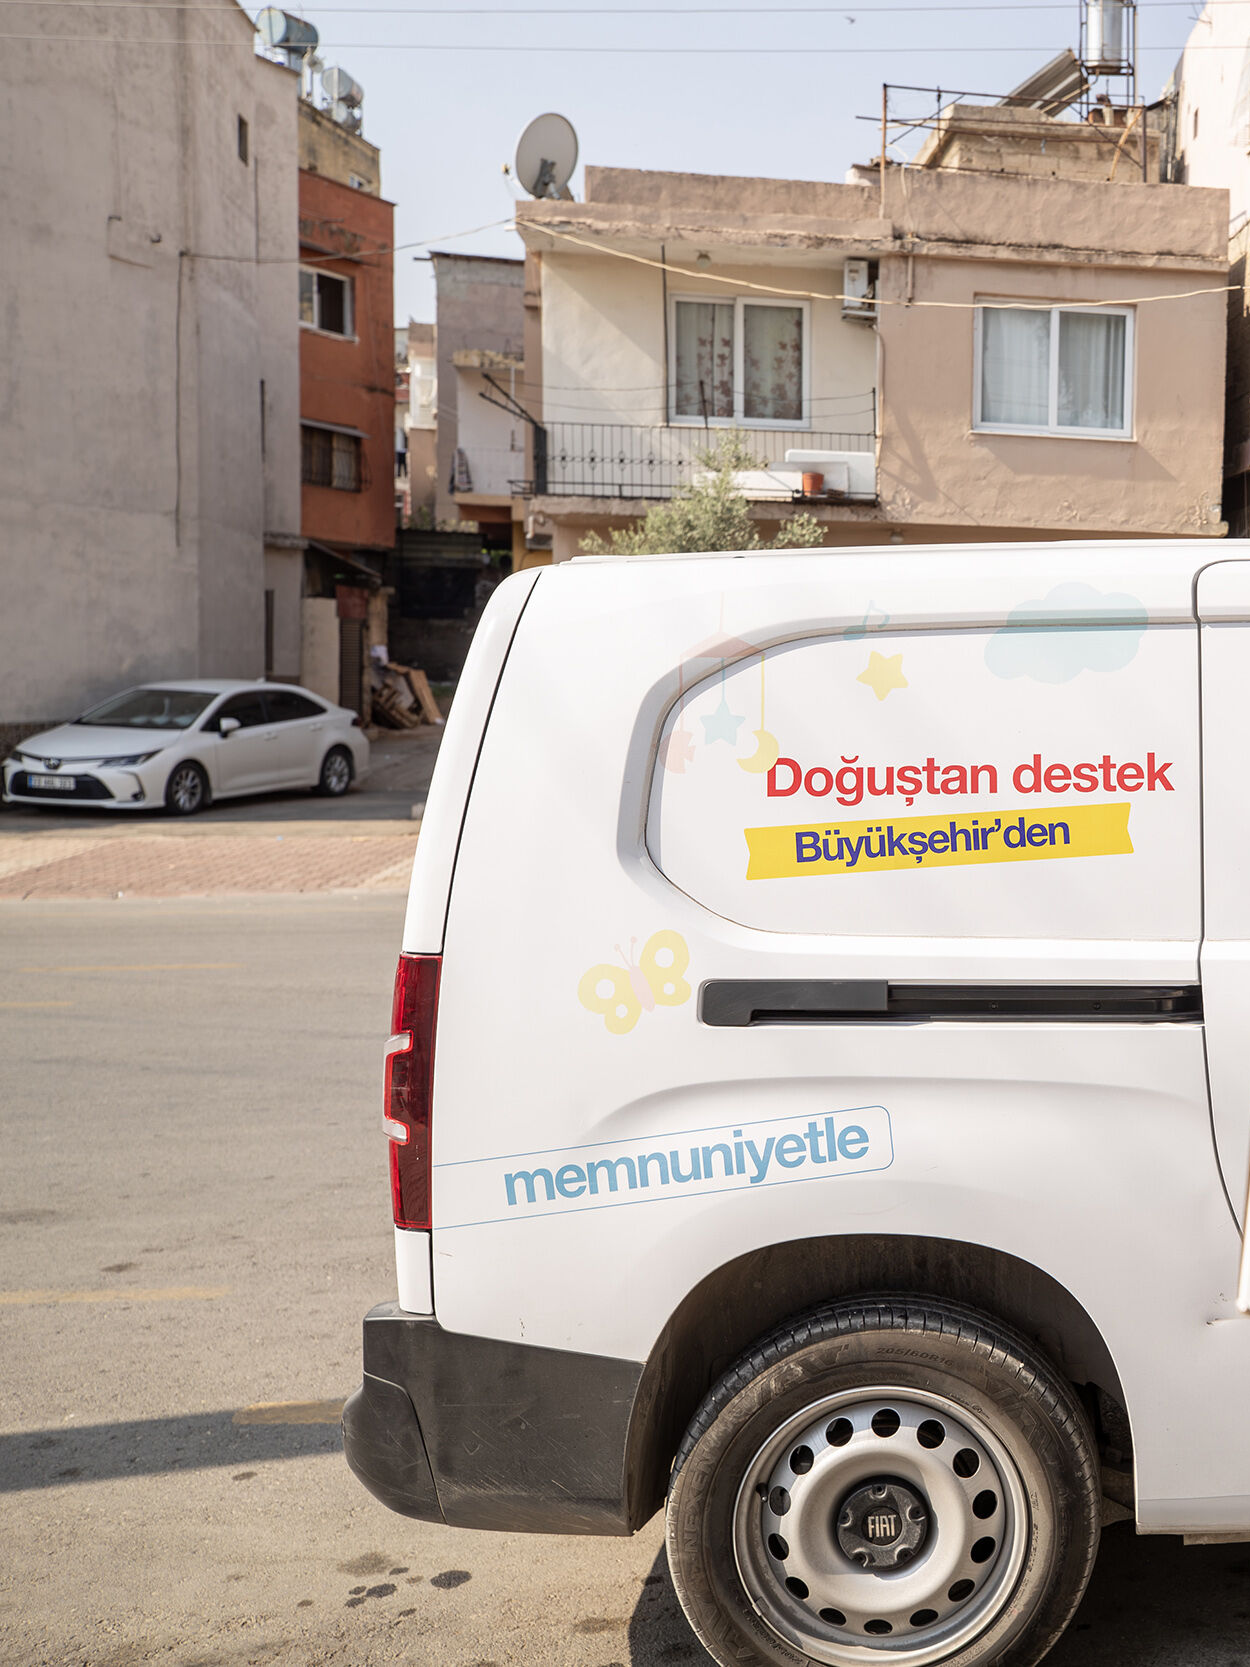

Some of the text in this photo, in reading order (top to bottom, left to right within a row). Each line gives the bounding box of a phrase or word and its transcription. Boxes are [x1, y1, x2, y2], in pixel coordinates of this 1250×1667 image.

[766, 752, 1176, 807] Doğuştan destek
[504, 1116, 870, 1206] memnuniyetle
[867, 1514, 897, 1538] FIAT
